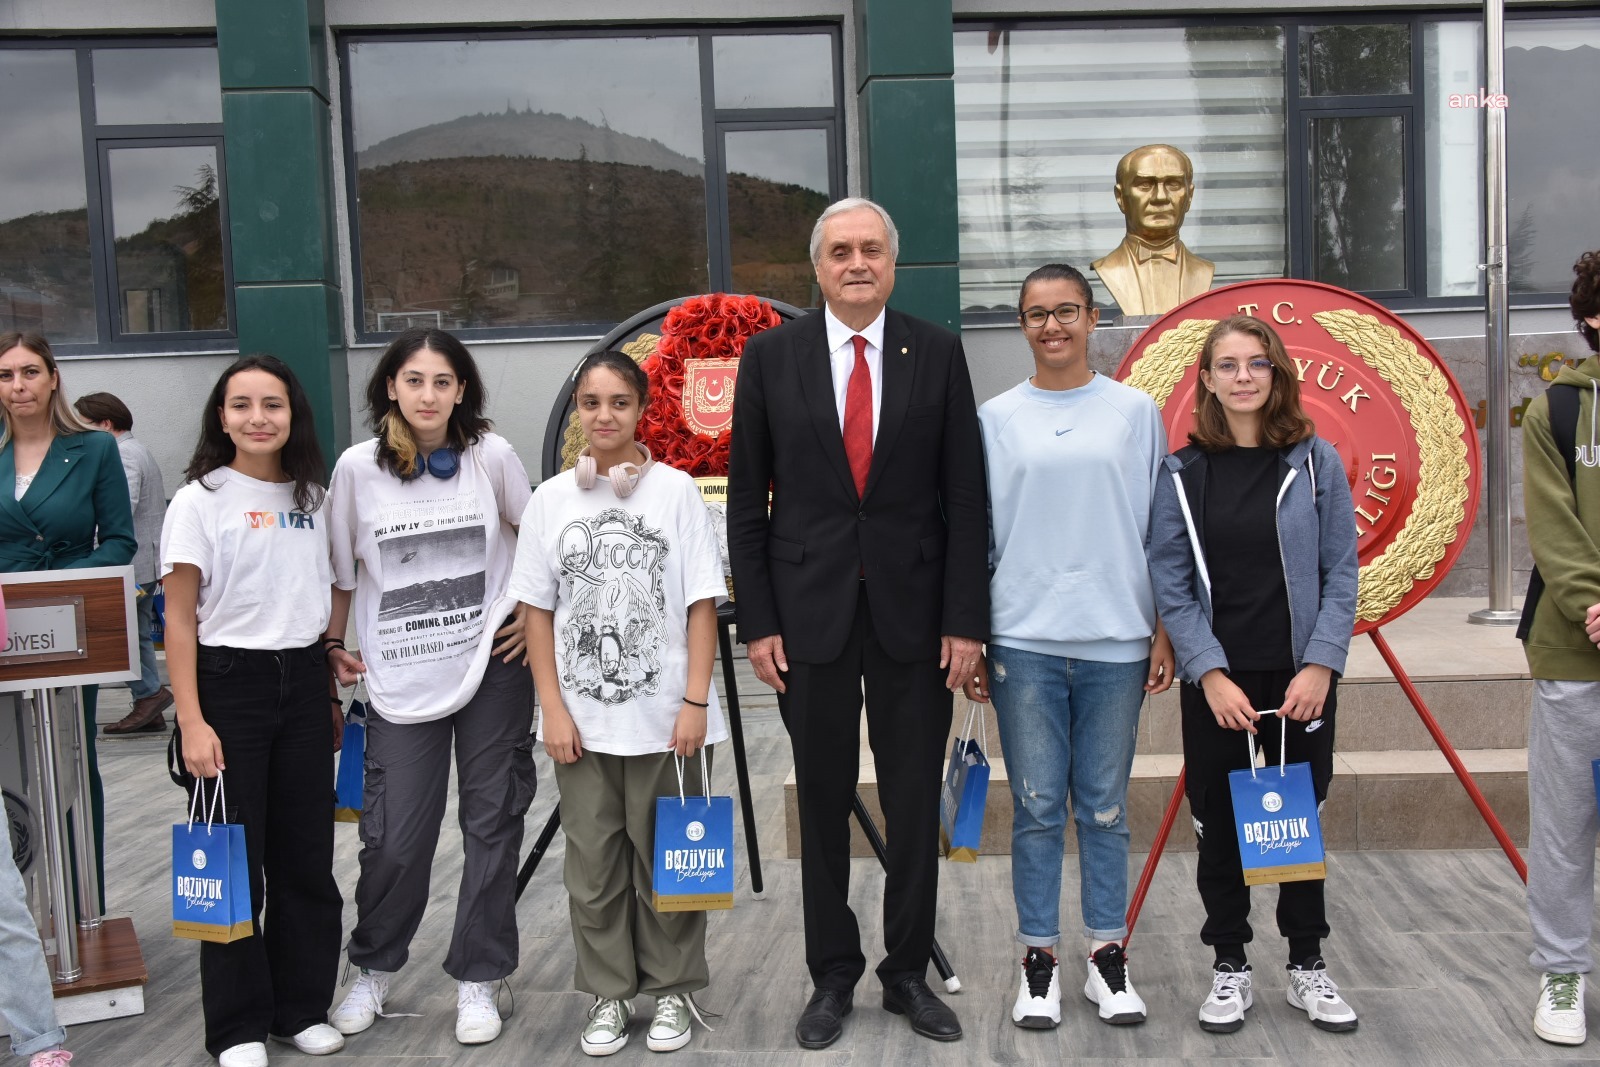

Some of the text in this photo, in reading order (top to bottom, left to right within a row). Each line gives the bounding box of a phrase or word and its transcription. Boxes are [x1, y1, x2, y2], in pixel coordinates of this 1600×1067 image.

[1291, 356, 1371, 414] YÜK
[390, 524, 406, 534] ANY
[437, 517, 456, 526] THINK
[405, 617, 441, 633] COMING
[443, 612, 467, 627] BACK
[3, 629, 55, 652] DİYESİ
[381, 648, 398, 661] NEW
[400, 644, 419, 659] FILM
[421, 640, 444, 655] BASED
[1244, 817, 1310, 843] BOZÜYÜK
[665, 848, 725, 870] BOZÜYÜK
[177, 876, 222, 900] BOZÜYÜK
